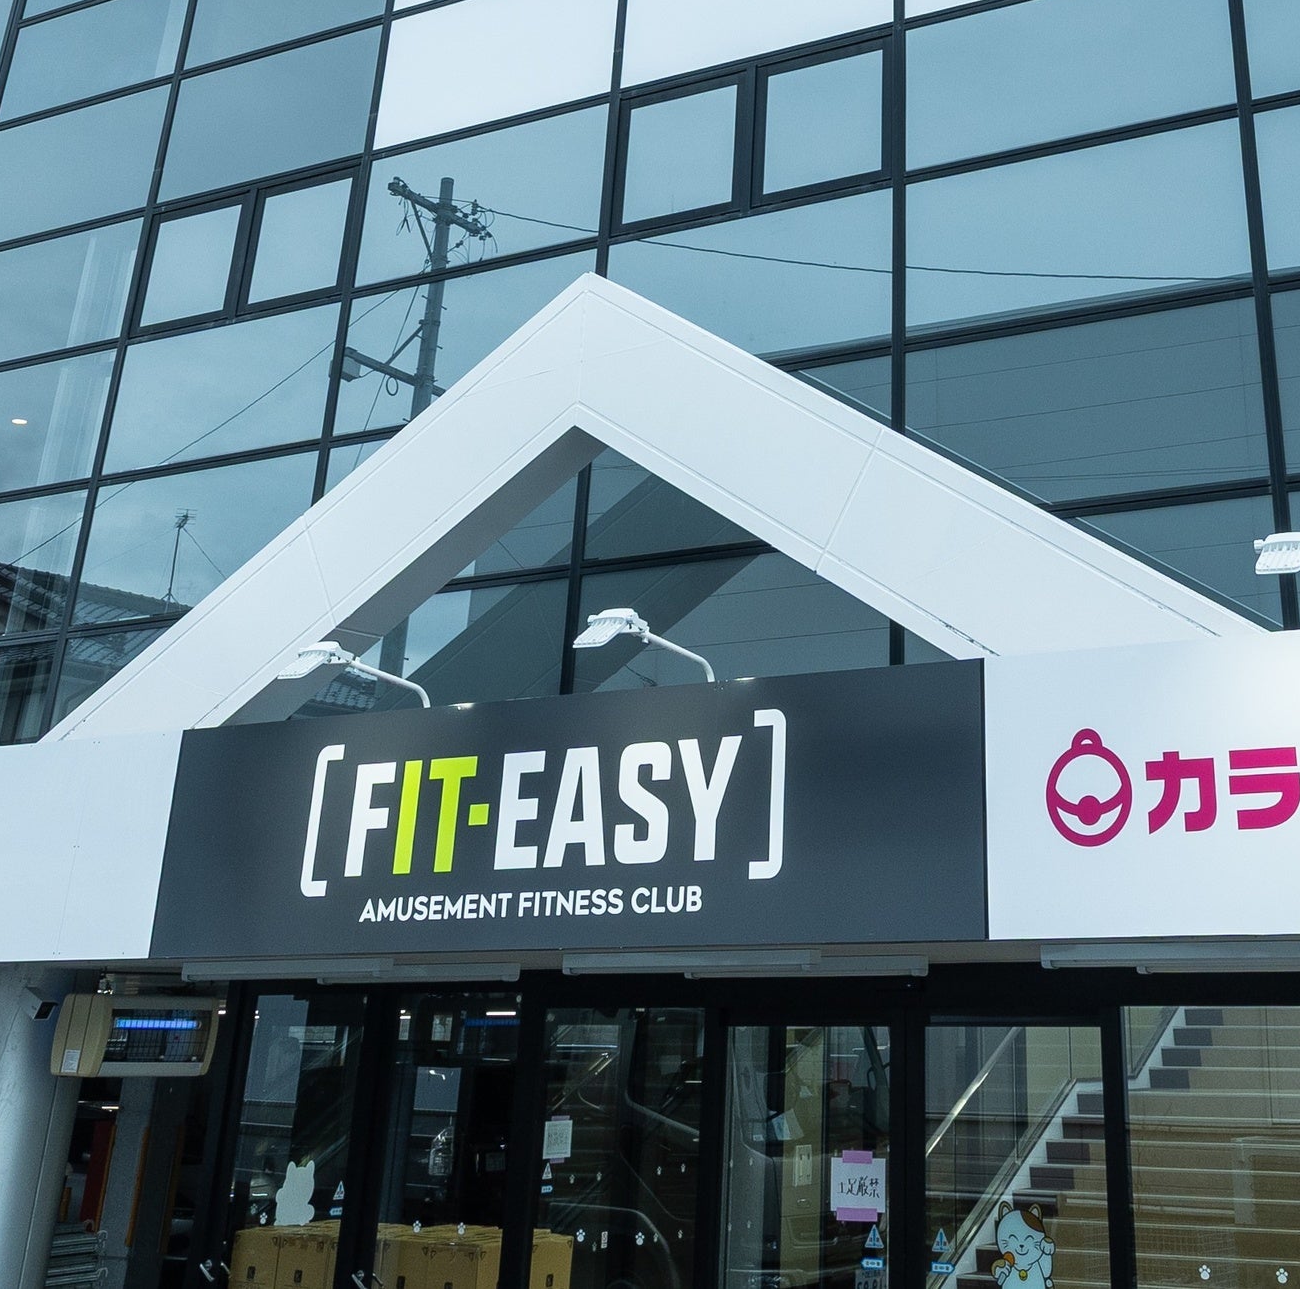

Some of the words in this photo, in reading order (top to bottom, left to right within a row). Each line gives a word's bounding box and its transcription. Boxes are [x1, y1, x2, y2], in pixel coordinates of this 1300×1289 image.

[358, 892, 513, 923] AMUSEMENT
[517, 887, 625, 917] FITNESS
[630, 885, 703, 914] CLUB
